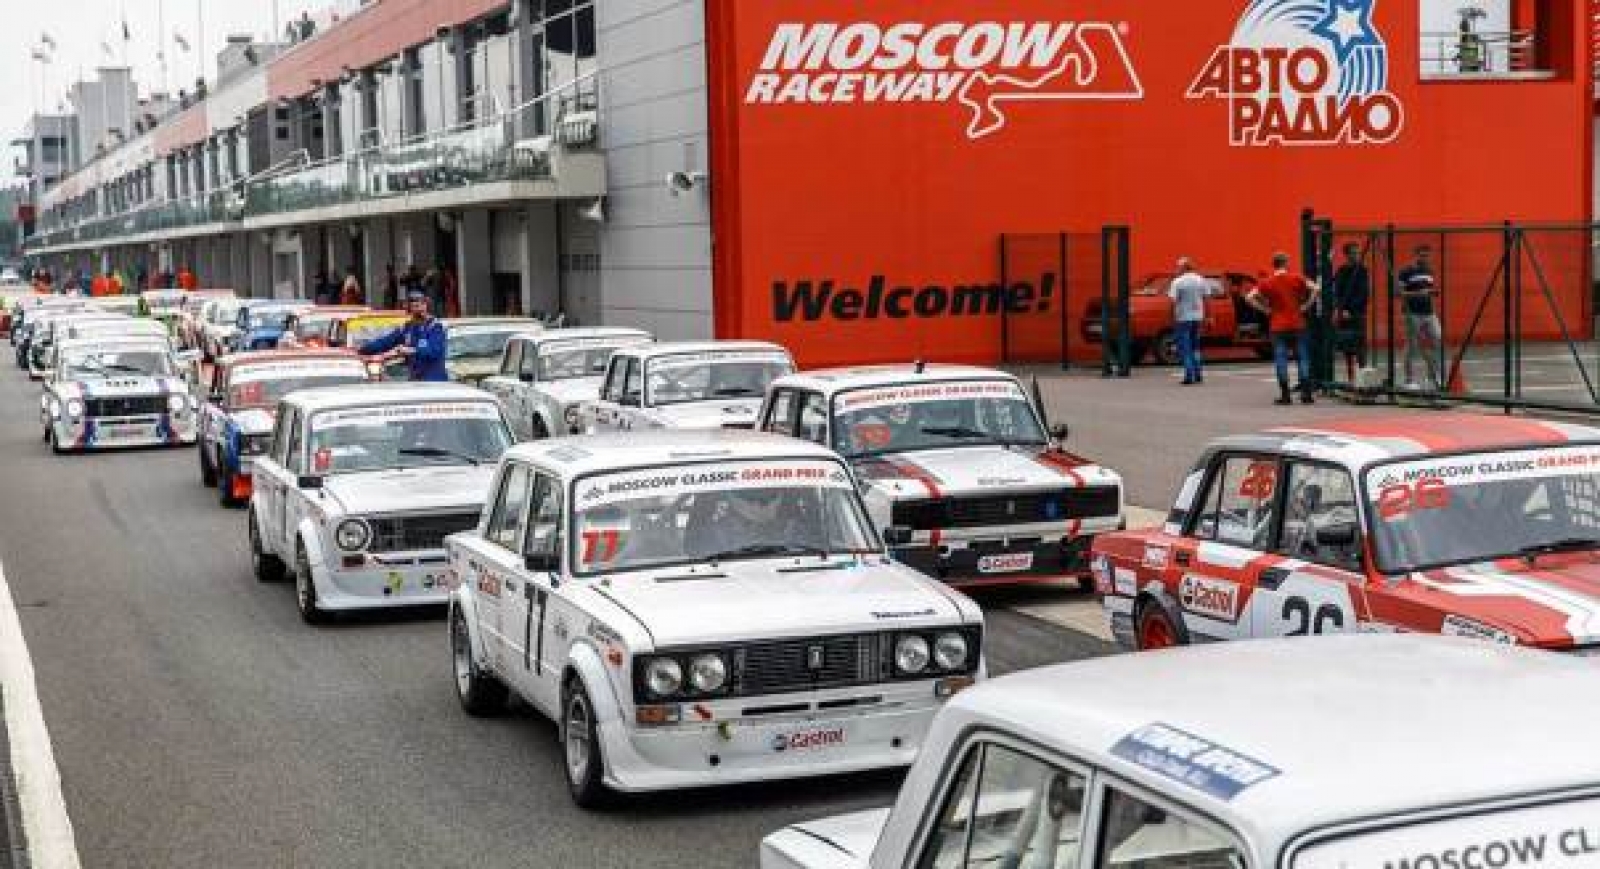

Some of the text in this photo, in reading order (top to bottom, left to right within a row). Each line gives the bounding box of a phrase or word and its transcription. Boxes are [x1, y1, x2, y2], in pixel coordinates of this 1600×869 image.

[759, 21, 1075, 71] MOSCOW
[745, 69, 966, 104] RACEWAY
[1187, 46, 1330, 97] АВТО
[1230, 95, 1404, 144] РАДИО
[771, 272, 1056, 323] Welcome!
[608, 467, 826, 494] MOSCOW CLASSIC GRAND PRIX
[1404, 463, 1475, 482] MOSCOW
[1477, 458, 1536, 474] CLASSIC
[1537, 454, 1589, 467] GRAND
[1379, 475, 1448, 519] 26
[582, 528, 622, 566] 77
[1193, 581, 1237, 617] Castrol
[791, 727, 845, 750] Castrol
